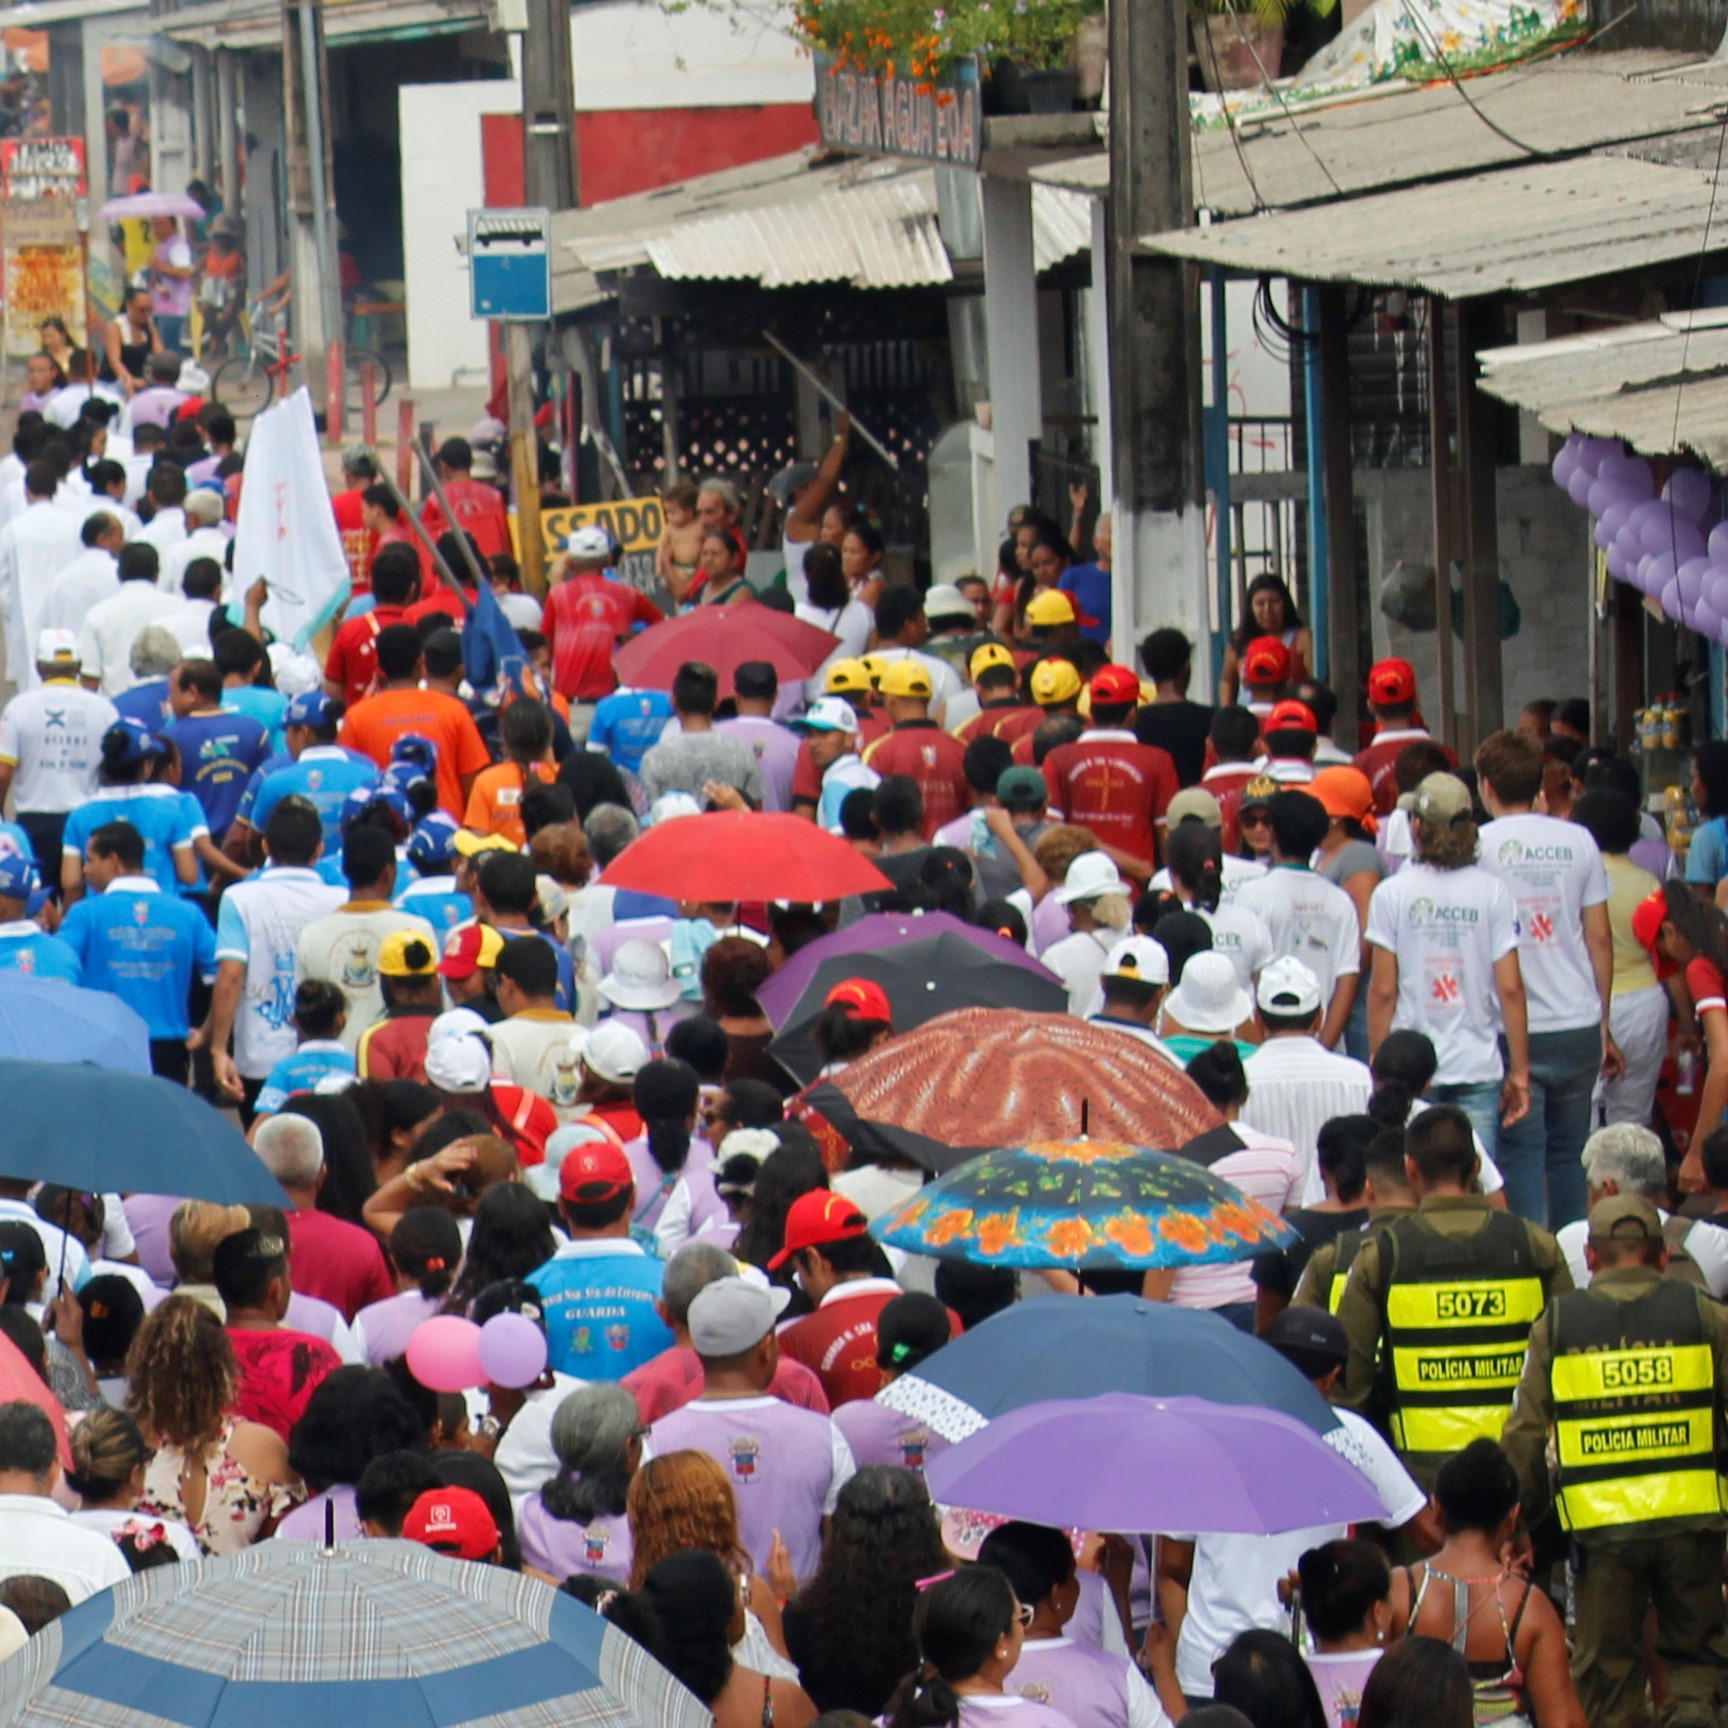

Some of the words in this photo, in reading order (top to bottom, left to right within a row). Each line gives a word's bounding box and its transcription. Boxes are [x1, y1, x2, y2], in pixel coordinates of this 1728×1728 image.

[1525, 846, 1574, 862] ACCEB
[1434, 906, 1480, 923] ACCEB
[565, 1306, 627, 1320] GUARDA
[1437, 1290, 1505, 1317] 5073
[1420, 1359, 1472, 1381] POLÍCIA
[1604, 1358, 1672, 1386] 5058
[1583, 1429, 1636, 1453] POLÍCIA
[1637, 1424, 1688, 1447] MILITAR
